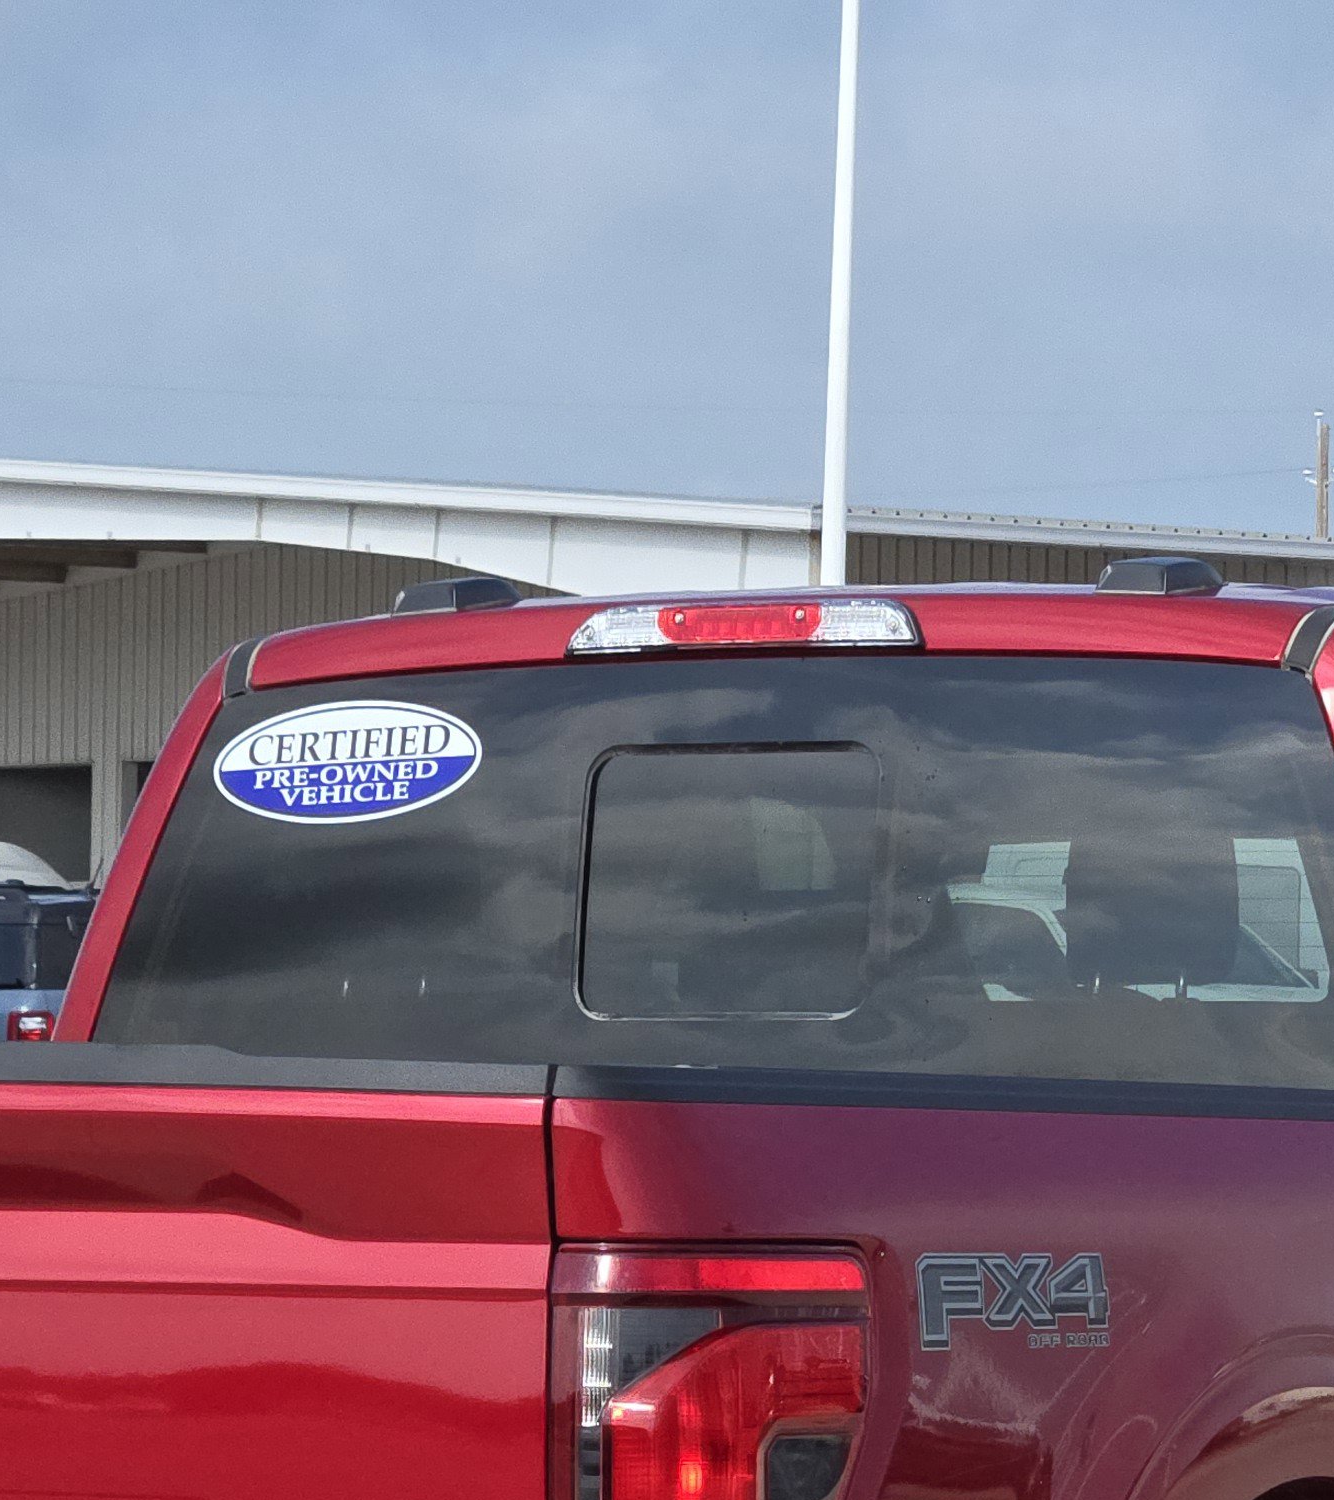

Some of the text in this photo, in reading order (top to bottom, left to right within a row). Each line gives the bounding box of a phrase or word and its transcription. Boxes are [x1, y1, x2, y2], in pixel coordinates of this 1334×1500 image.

[249, 724, 451, 766] CERTIFIED
[253, 760, 439, 789] PRE-OWNED
[279, 781, 410, 806] VEHICLE
[915, 1252, 1110, 1351] FX4
